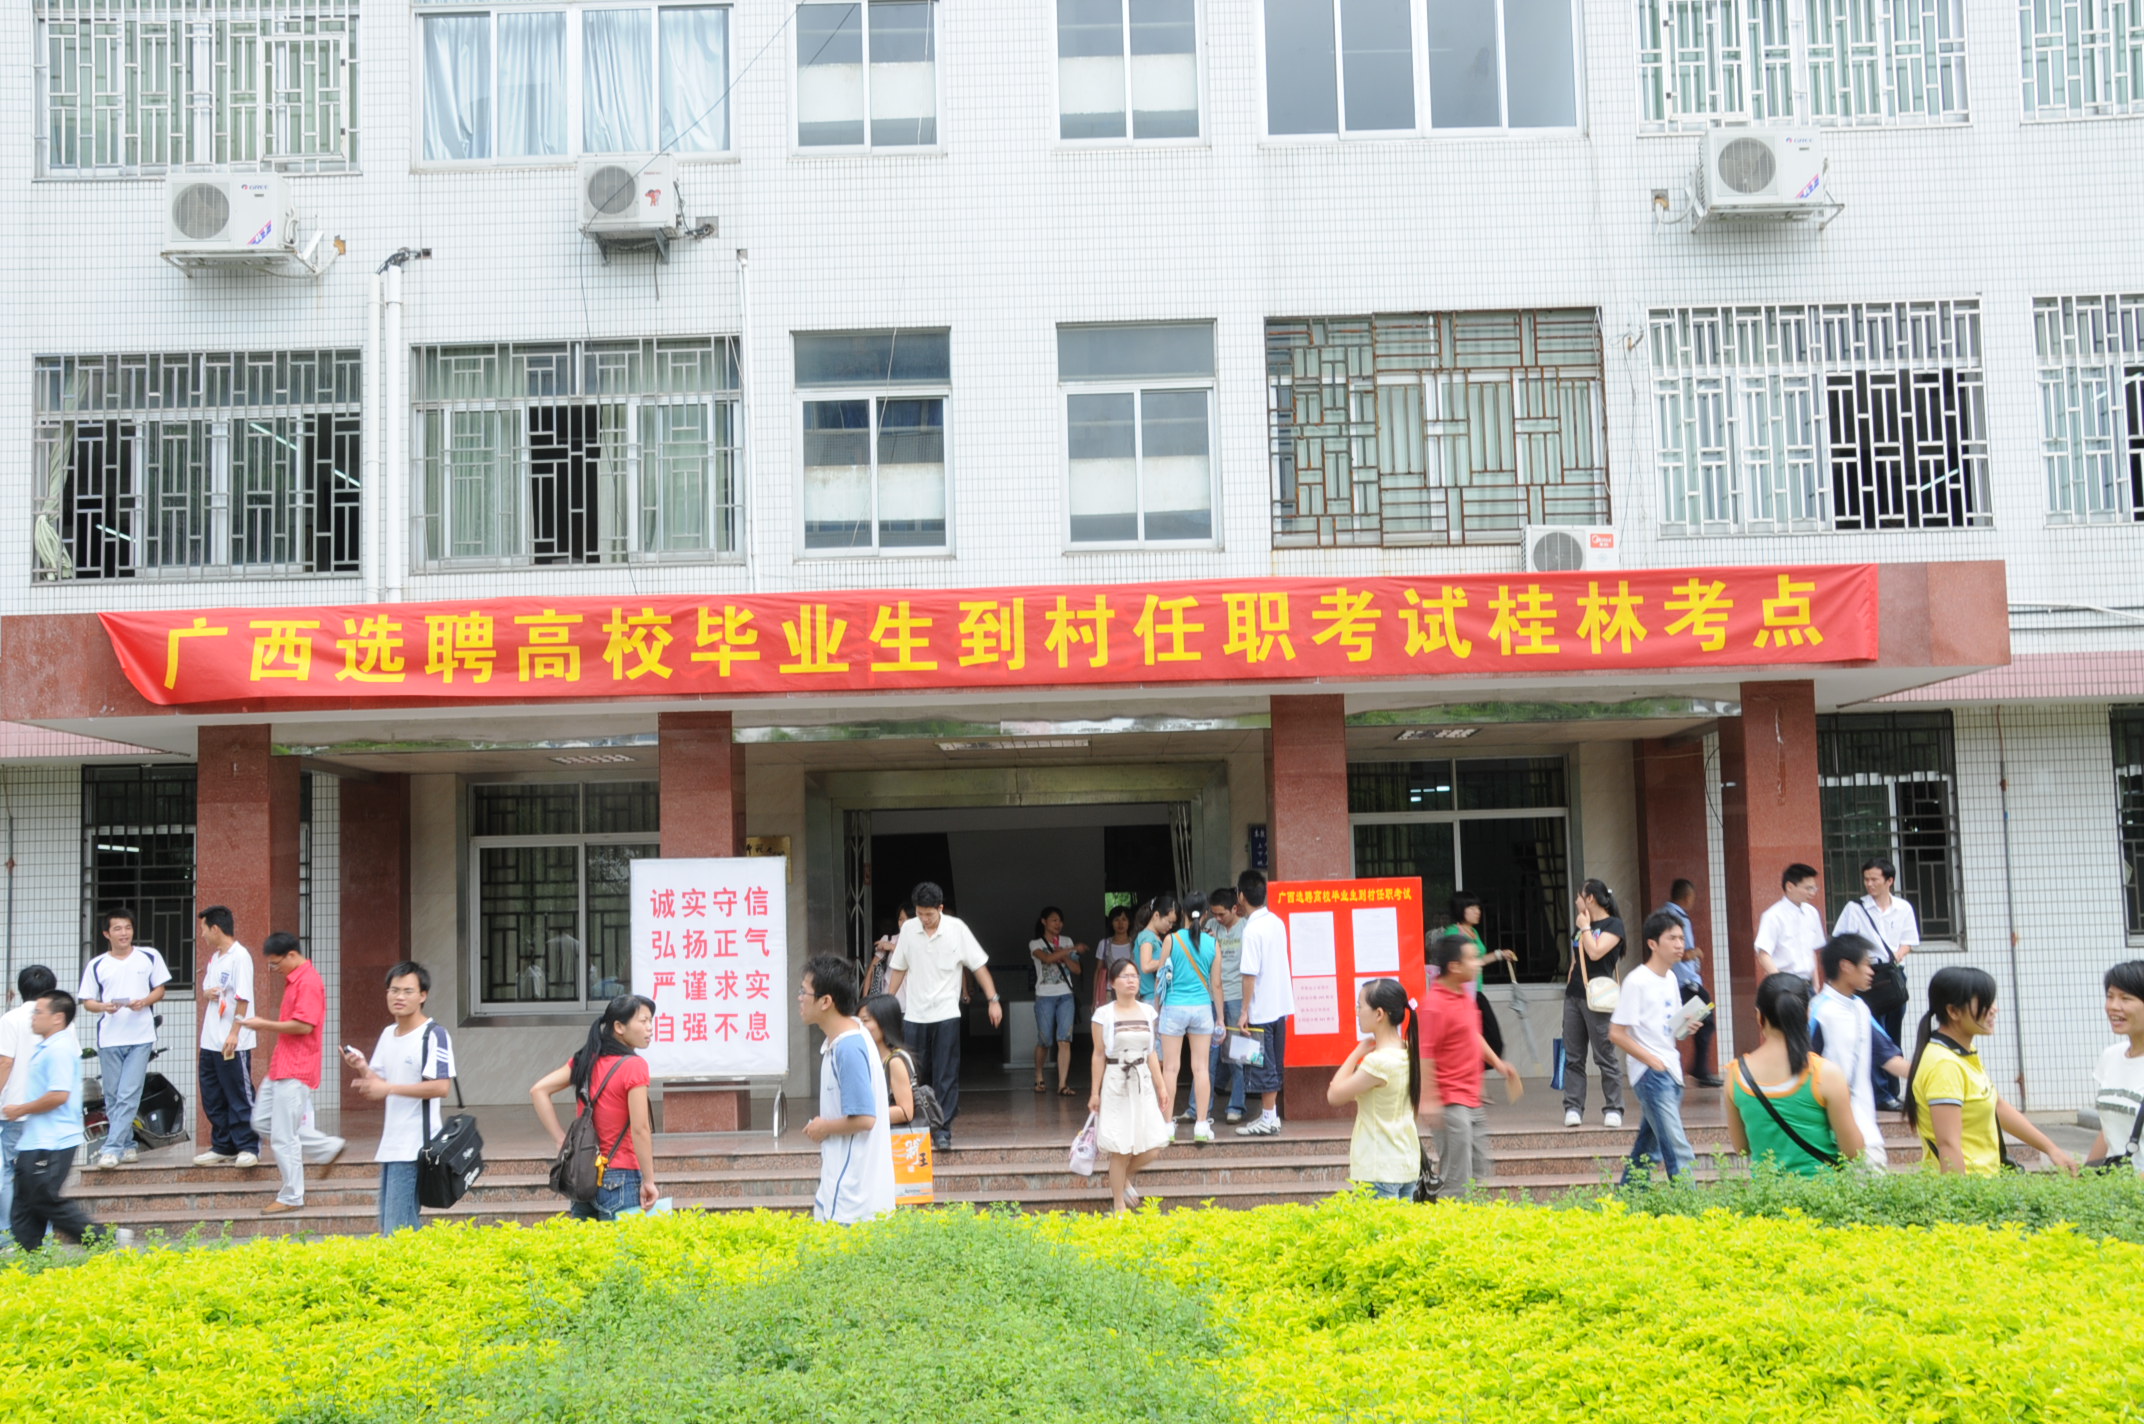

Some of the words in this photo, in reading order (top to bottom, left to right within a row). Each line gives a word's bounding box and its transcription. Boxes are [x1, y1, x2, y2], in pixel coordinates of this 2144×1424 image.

[164, 574, 1824, 690] 广西选聘高校毕业生到村任职考试桂林考点
[650, 886, 769, 918] 诚实守信
[1277, 887, 1412, 904] 广西选聘高校毕业生到村任职考试
[651, 927, 770, 960] 弘扬正气
[652, 970, 770, 1001] 严谨求实
[654, 1011, 771, 1042] 自强不息
